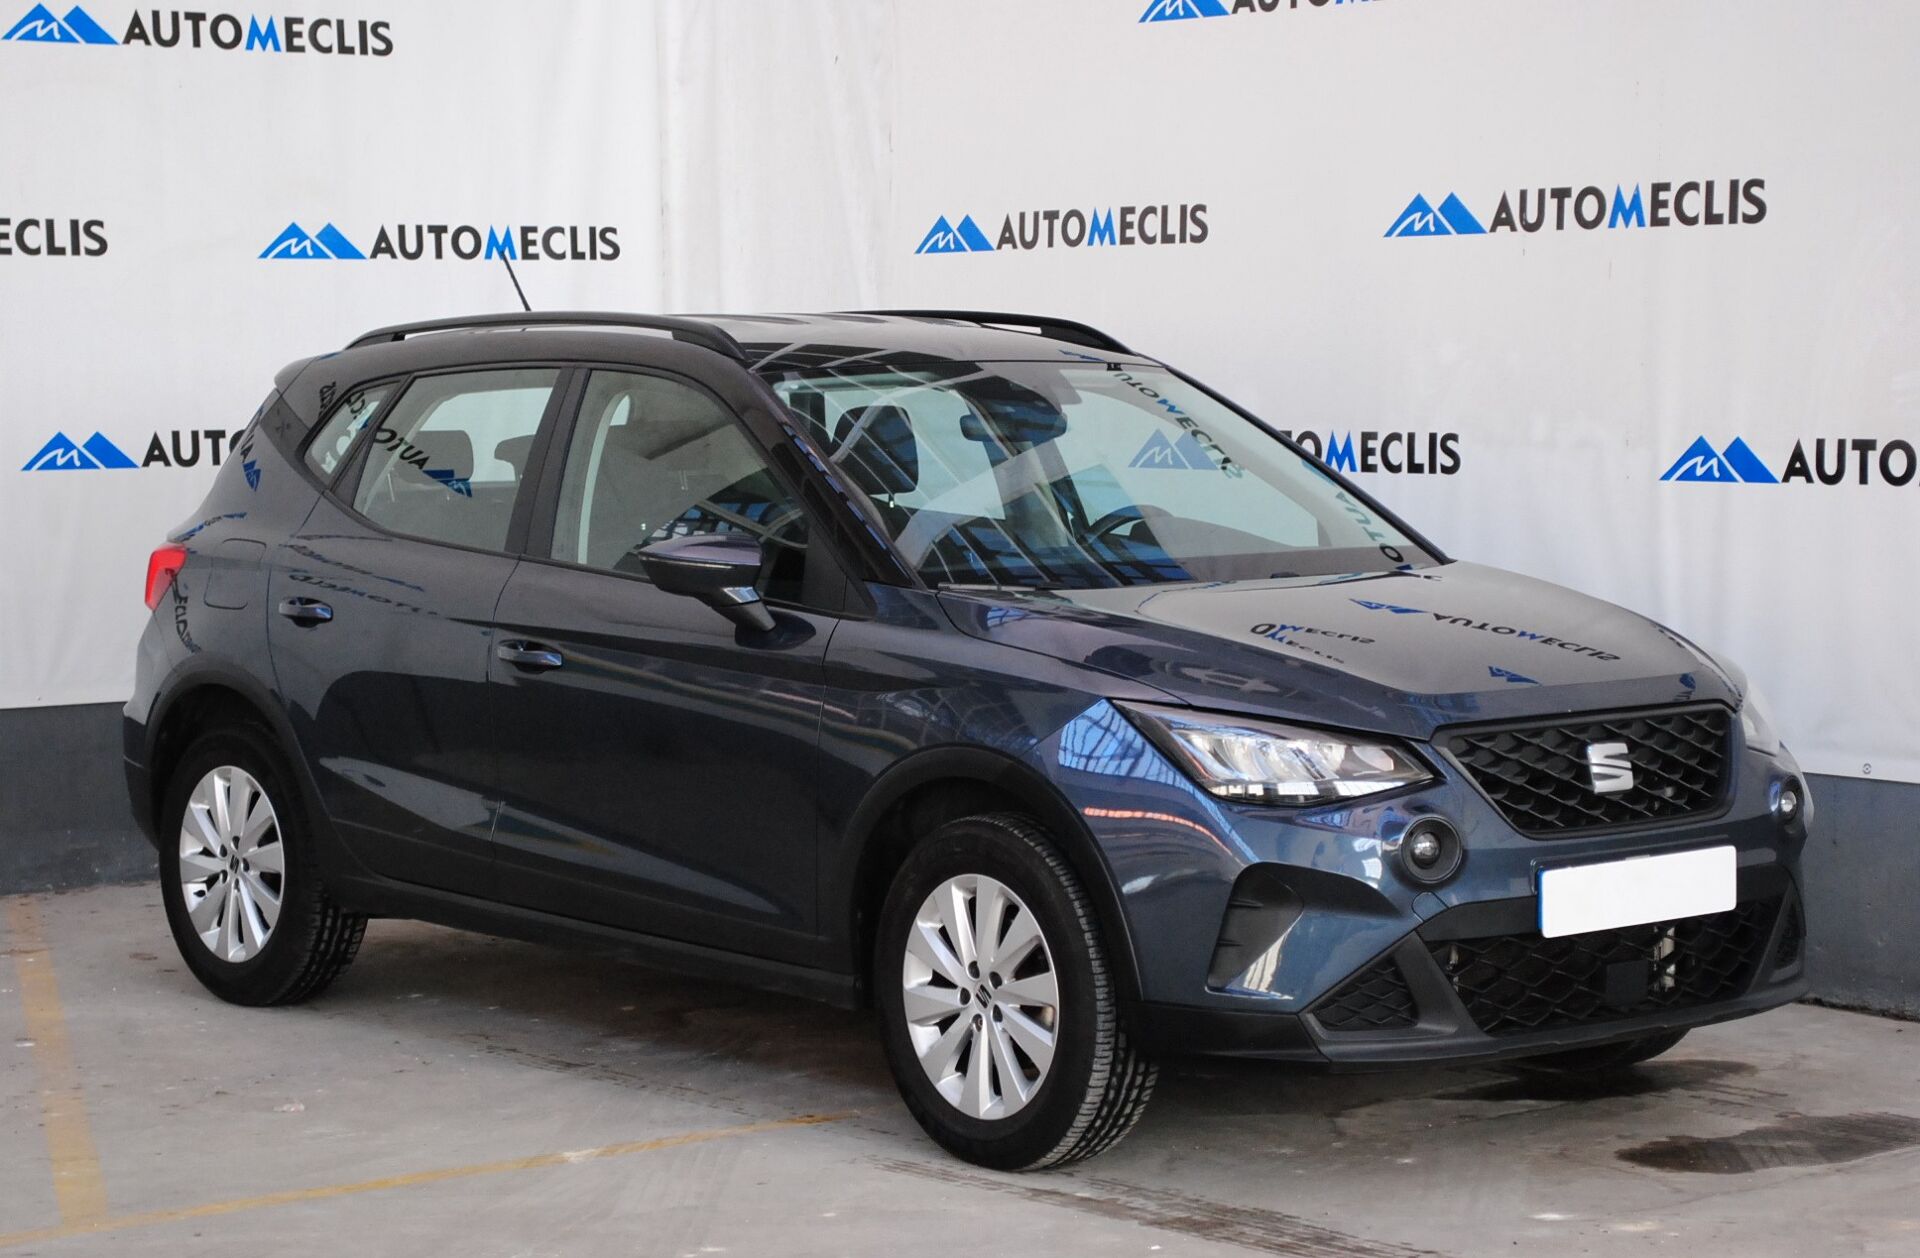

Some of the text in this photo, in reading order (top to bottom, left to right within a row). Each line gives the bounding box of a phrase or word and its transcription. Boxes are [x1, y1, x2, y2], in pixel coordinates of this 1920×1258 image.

[123, 10, 393, 57] AUTOMECLIS
[1000, 205, 1208, 250] AUTOMECLIS
[1493, 179, 1767, 233] AUTOMECLIS
[369, 224, 621, 262] AUTOMECLIS
[1279, 429, 1461, 476] OMECLIS
